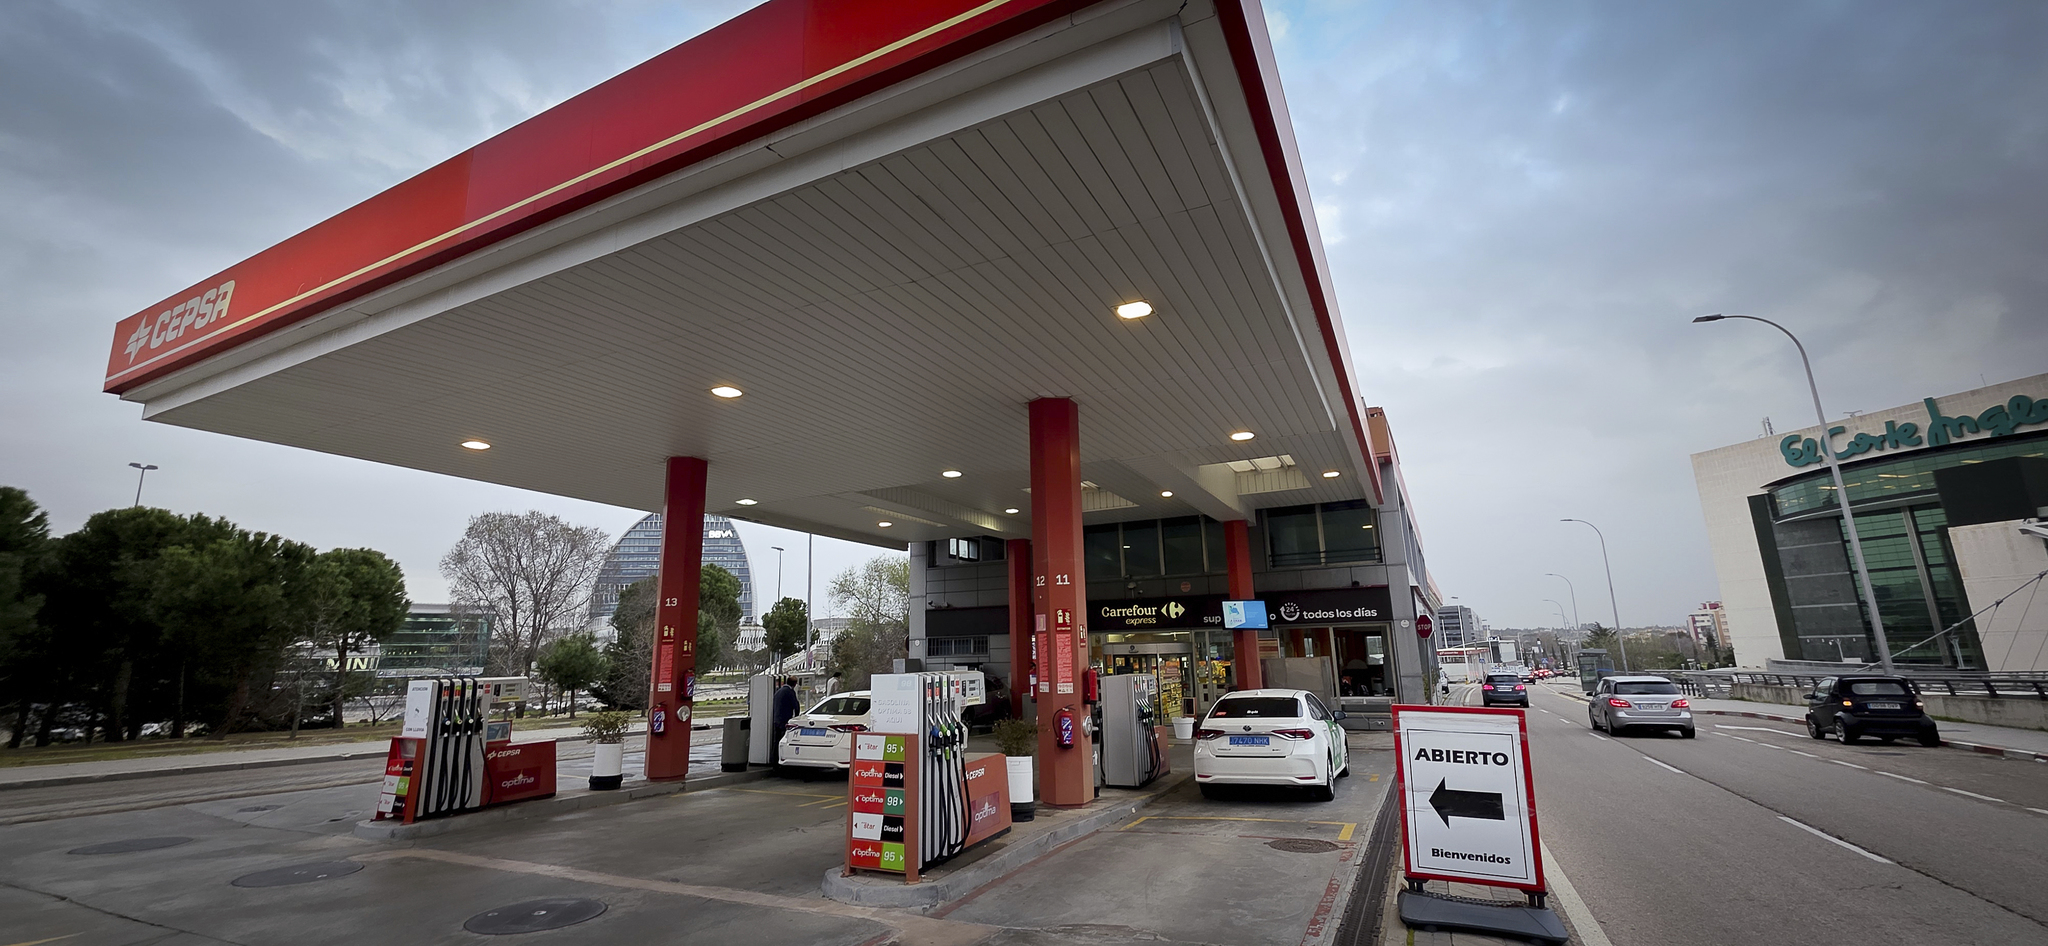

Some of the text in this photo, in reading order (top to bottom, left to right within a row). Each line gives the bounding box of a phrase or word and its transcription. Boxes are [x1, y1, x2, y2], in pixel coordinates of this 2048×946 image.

[149, 279, 236, 349] CEPSA
[1780, 434, 1822, 467] El
[1820, 420, 1922, 460] Corte
[708, 529, 733, 538] BBVA
[1036, 575, 1046, 586] 12
[1055, 574, 1070, 586] 11
[665, 597, 678, 607] 13
[1101, 604, 1157, 617] Carrefour
[1303, 607, 1377, 619] todos los días
[1125, 616, 1157, 626] express
[497, 748, 521, 758] CEPSA
[886, 743, 898, 753] 95
[1414, 747, 1509, 767] ABIERTO
[860, 770, 883, 779] optima
[969, 767, 985, 780] CEPSA
[501, 774, 535, 789] optima
[861, 795, 898, 806] optima 98
[974, 806, 997, 823] optima
[857, 849, 896, 862] optima 95
[1431, 847, 1511, 865] Bienvenidos
